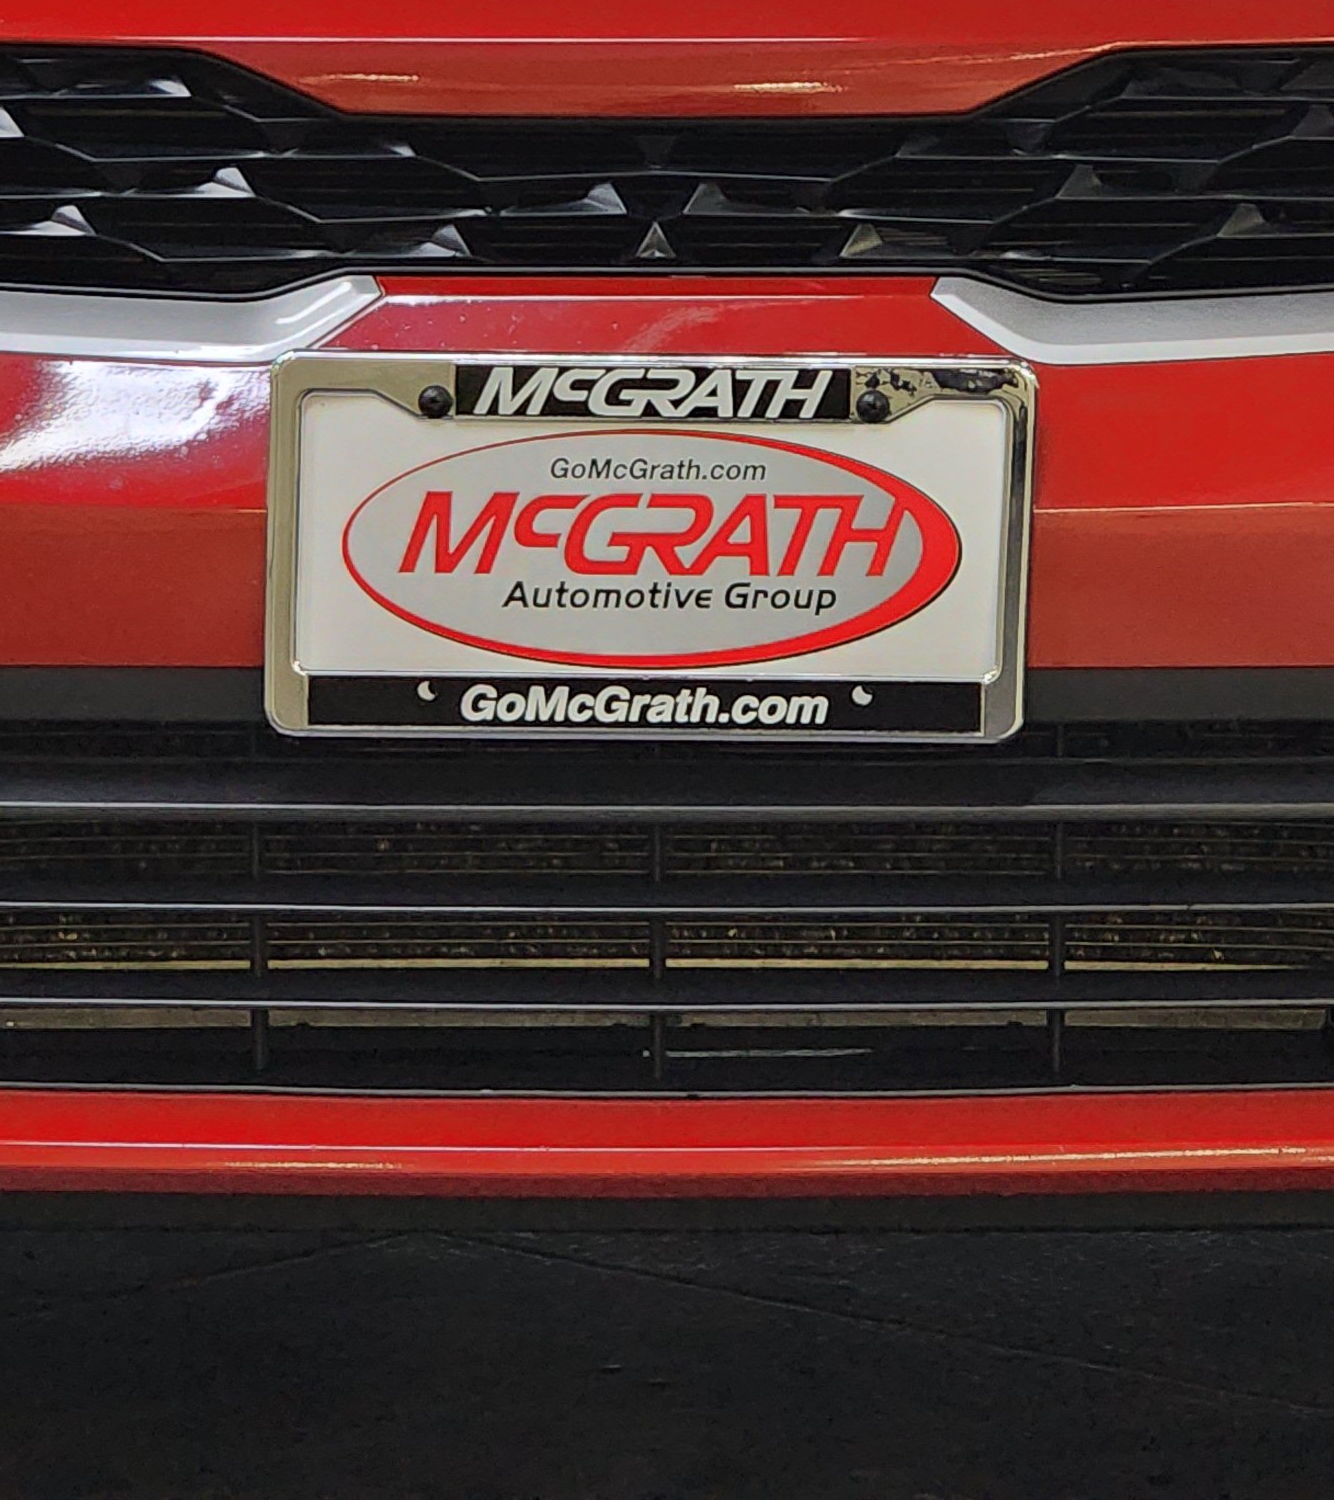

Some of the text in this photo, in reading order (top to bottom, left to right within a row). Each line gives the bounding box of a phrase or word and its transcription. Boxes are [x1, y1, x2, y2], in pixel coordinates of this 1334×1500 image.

[550, 457, 767, 482] GoMcGrath.com
[502, 581, 838, 617] Automotive Group
[460, 684, 828, 726] GoMcGrath.com
